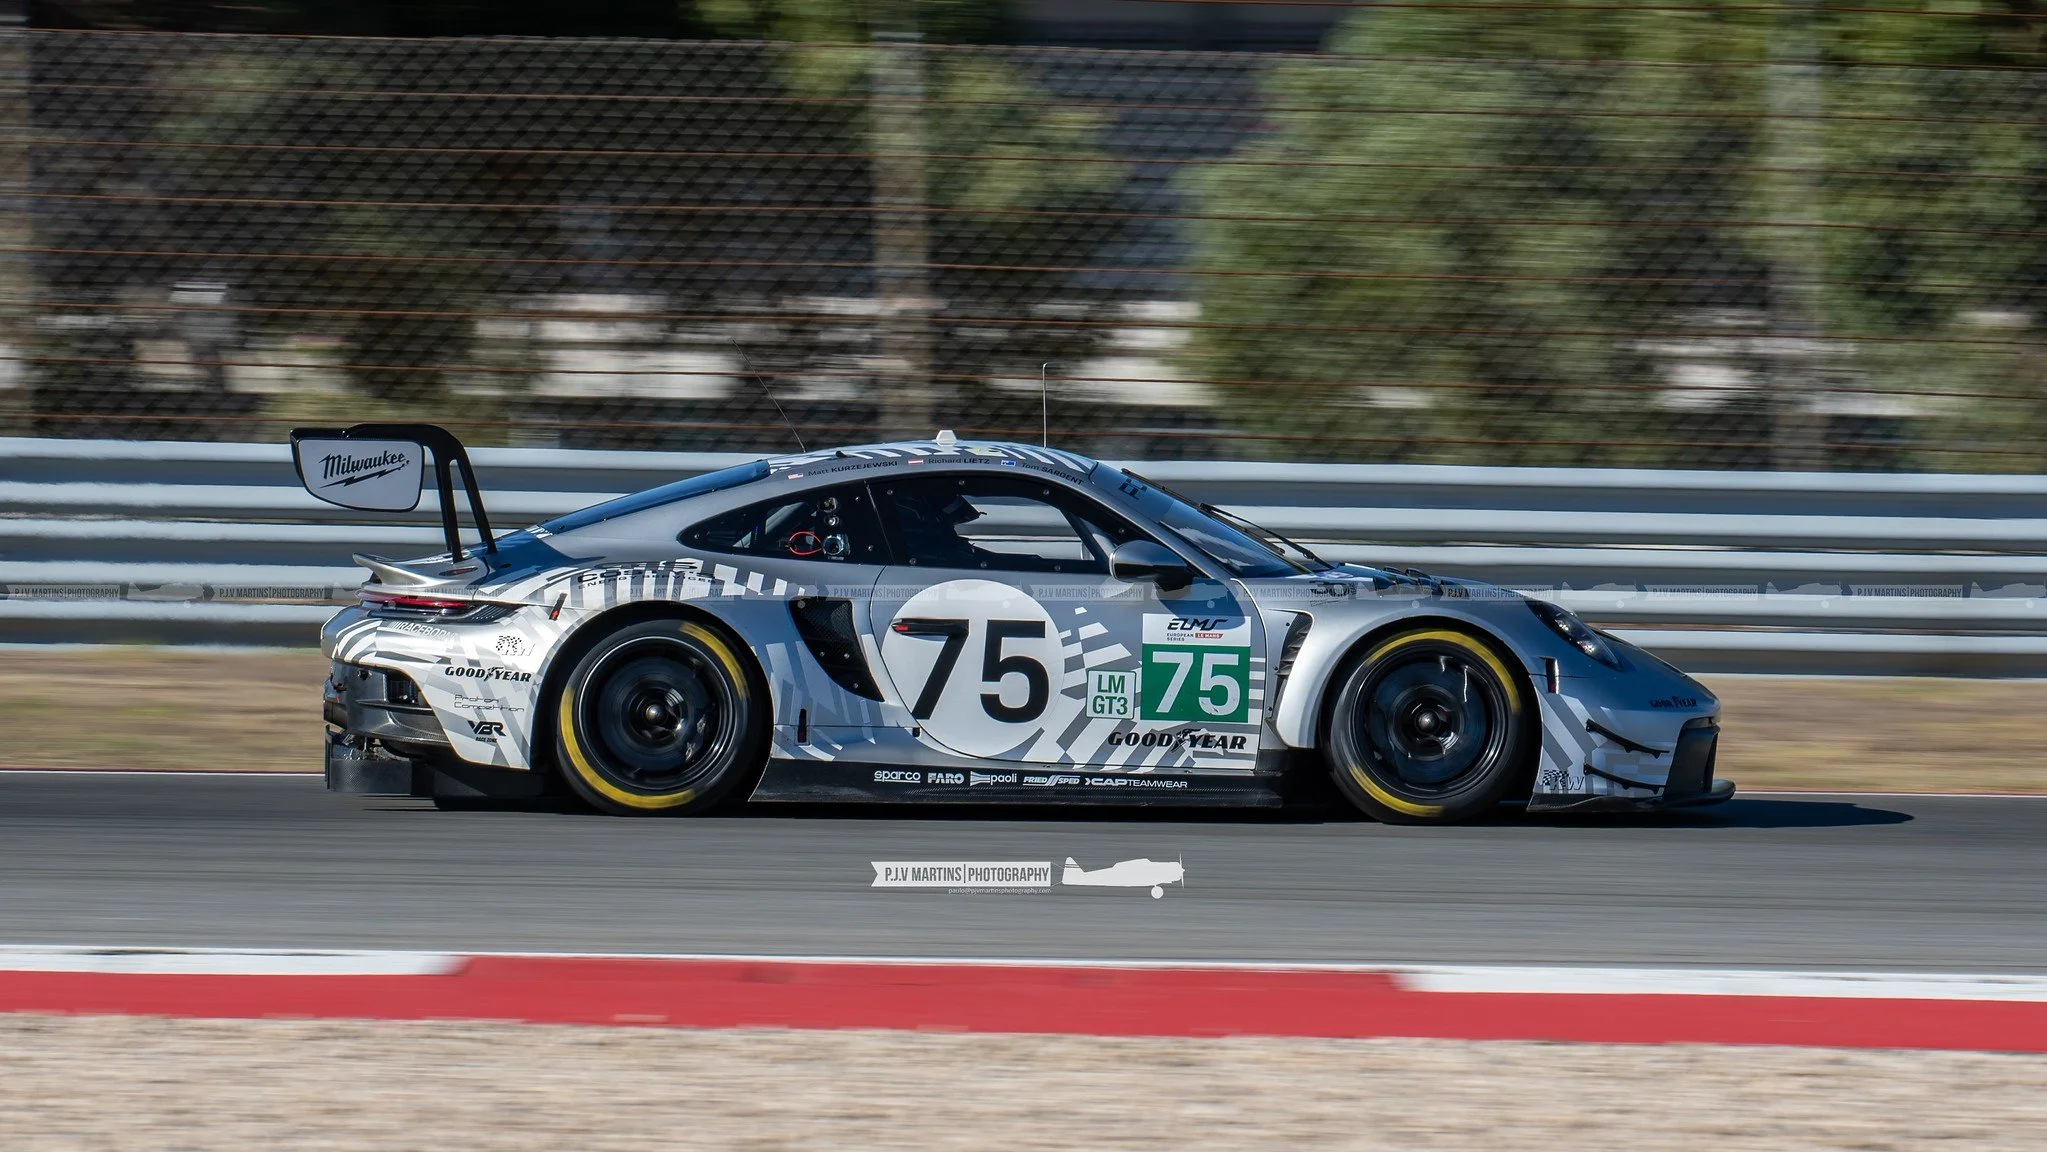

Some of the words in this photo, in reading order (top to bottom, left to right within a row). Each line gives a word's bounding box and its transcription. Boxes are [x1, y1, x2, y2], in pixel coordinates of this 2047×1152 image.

[318, 450, 406, 479] Milwaukee
[808, 466, 829, 477] Matt
[831, 460, 898, 473] KURZEJEWSKI
[1022, 462, 1039, 471] Tom
[1041, 466, 1084, 485] SARGENT
[893, 618, 1050, 723] 75
[1097, 674, 1126, 694] LM
[1152, 651, 1241, 716] 75
[454, 694, 500, 703] Proton
[454, 701, 525, 712] Competition
[1092, 695, 1128, 716] GT3
[874, 770, 921, 783] sparco
[927, 772, 965, 784] FARO
[990, 772, 1017, 785] paoli
